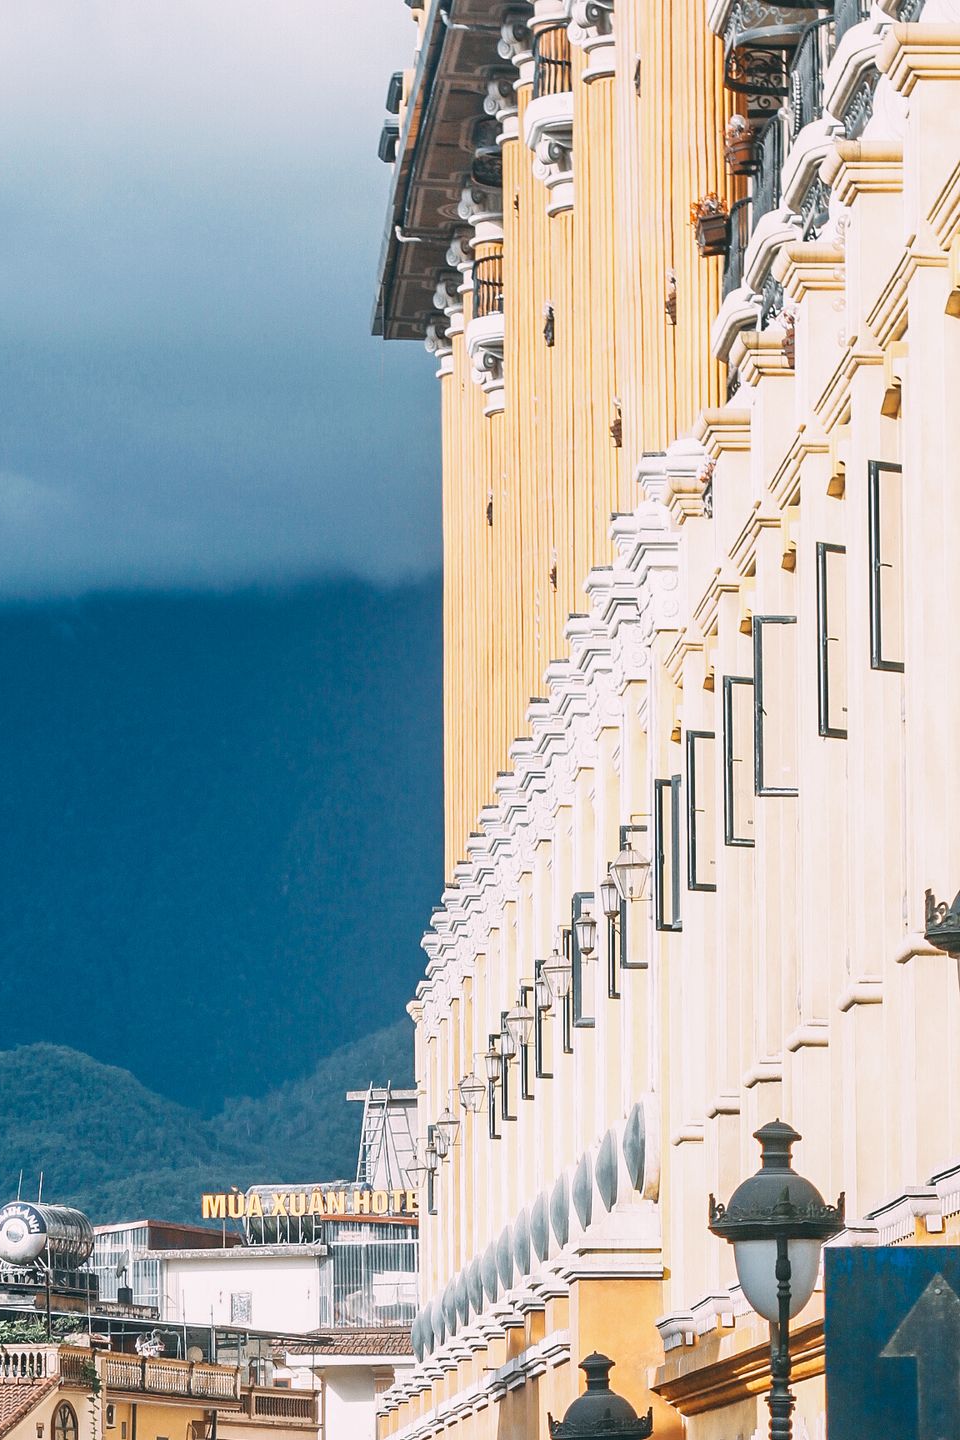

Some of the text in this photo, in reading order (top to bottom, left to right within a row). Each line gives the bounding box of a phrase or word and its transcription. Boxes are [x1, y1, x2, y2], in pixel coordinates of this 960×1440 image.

[202, 1185, 419, 1218] MÙA XUÂN HOTE
